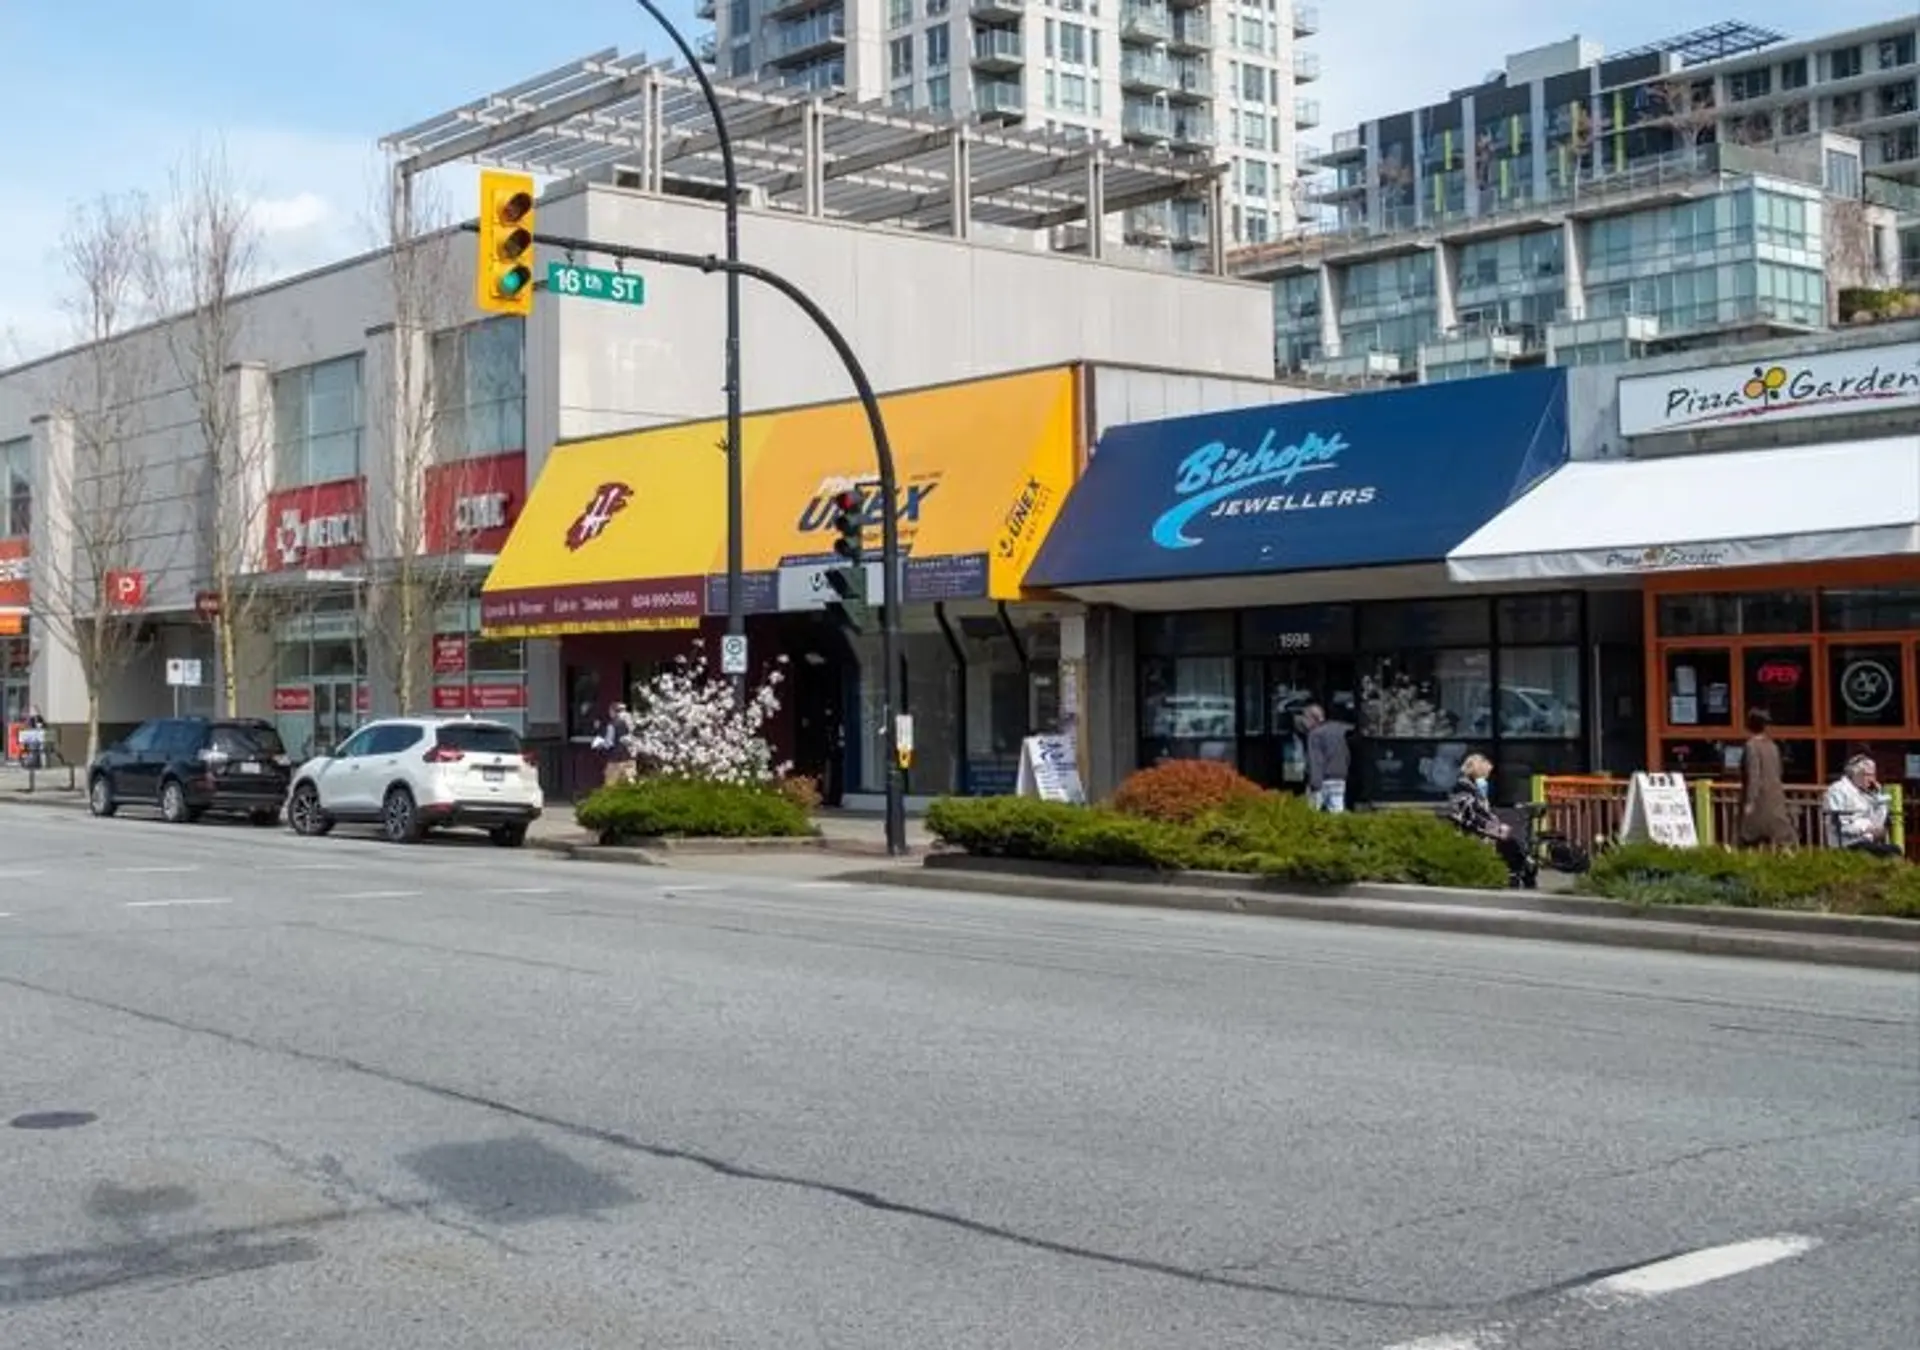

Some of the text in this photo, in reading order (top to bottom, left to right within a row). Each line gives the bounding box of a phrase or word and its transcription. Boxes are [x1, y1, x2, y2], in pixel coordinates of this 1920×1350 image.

[555, 268, 638, 299] 16 th ST
[1666, 366, 1920, 417] Pizza Garden
[1174, 428, 1350, 494] Bishops
[1006, 476, 1041, 538] UNEX
[1210, 487, 1376, 516] JEWELLERS
[1758, 664, 1800, 683] OPEN
